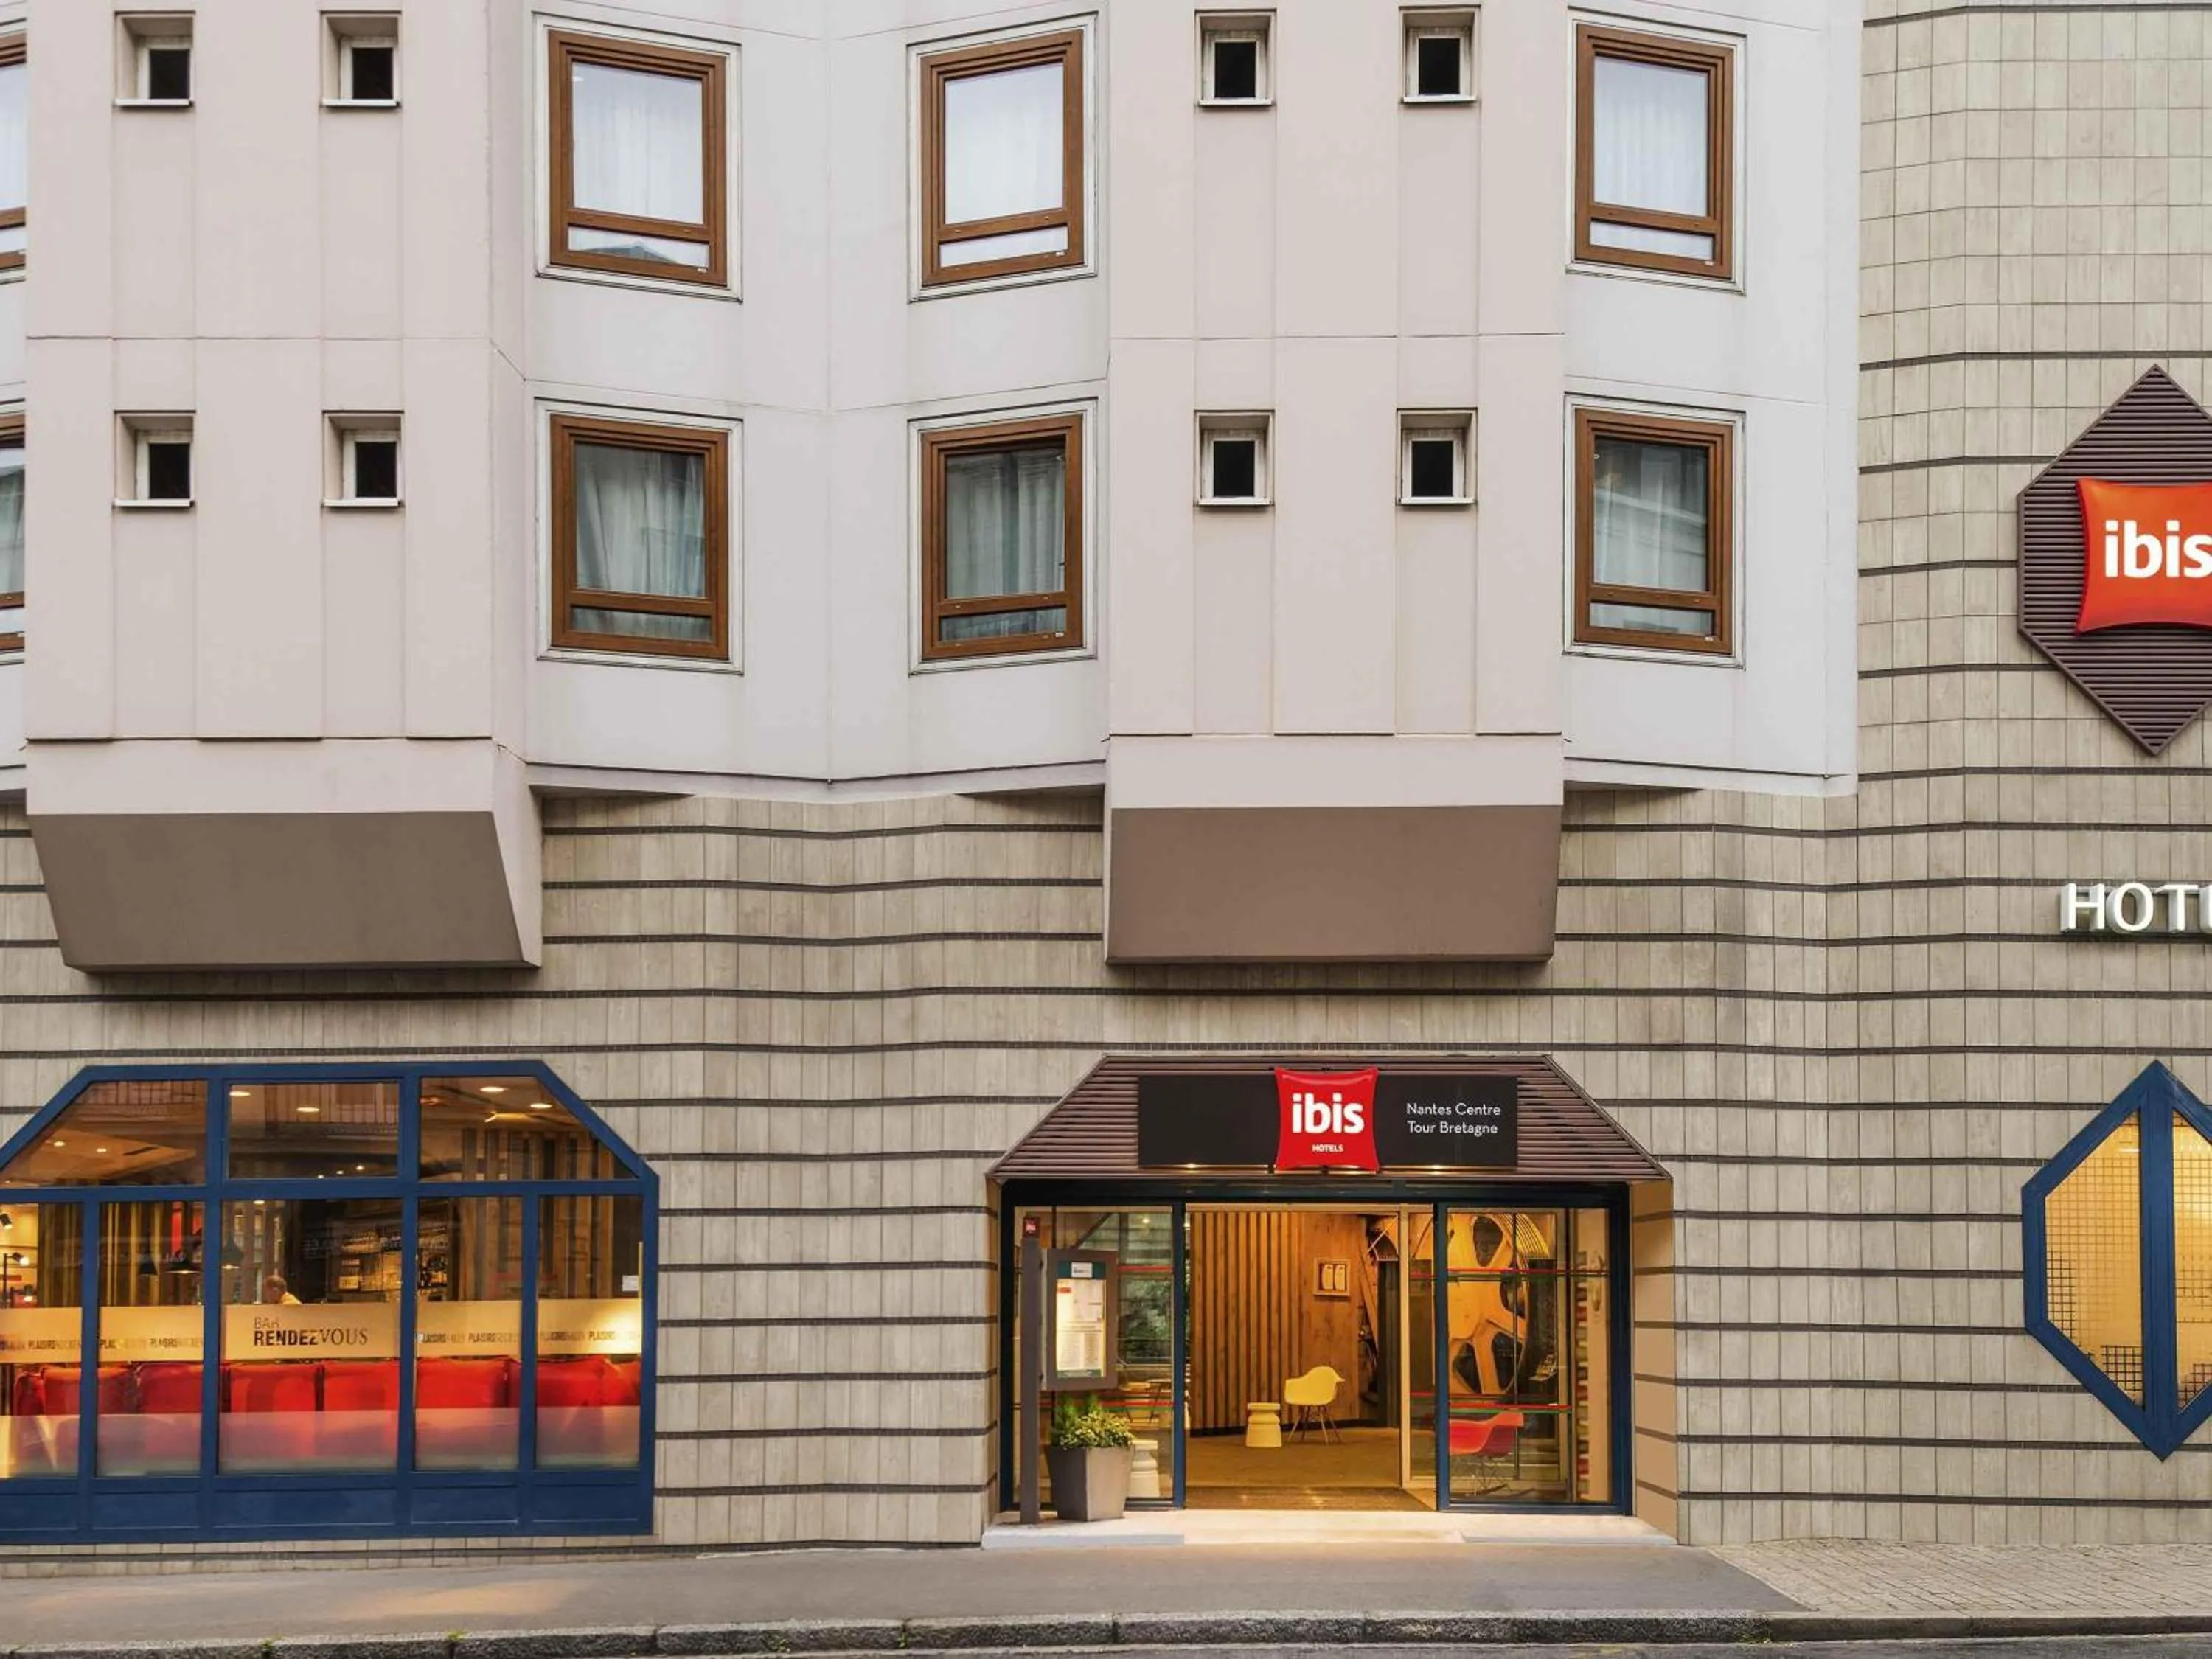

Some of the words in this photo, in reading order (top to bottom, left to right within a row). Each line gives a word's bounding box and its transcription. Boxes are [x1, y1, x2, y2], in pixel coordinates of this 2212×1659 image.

[2104, 519, 2212, 578] ibis
[2061, 883, 2212, 933] HOT
[1291, 1092, 1365, 1134] ibis
[1406, 1102, 1452, 1116] Nantes
[1455, 1102, 1501, 1116] Centre
[1408, 1120, 1436, 1134] Tour
[1439, 1120, 1498, 1137] Bretagne
[1311, 1143, 1344, 1153] HOTELS
